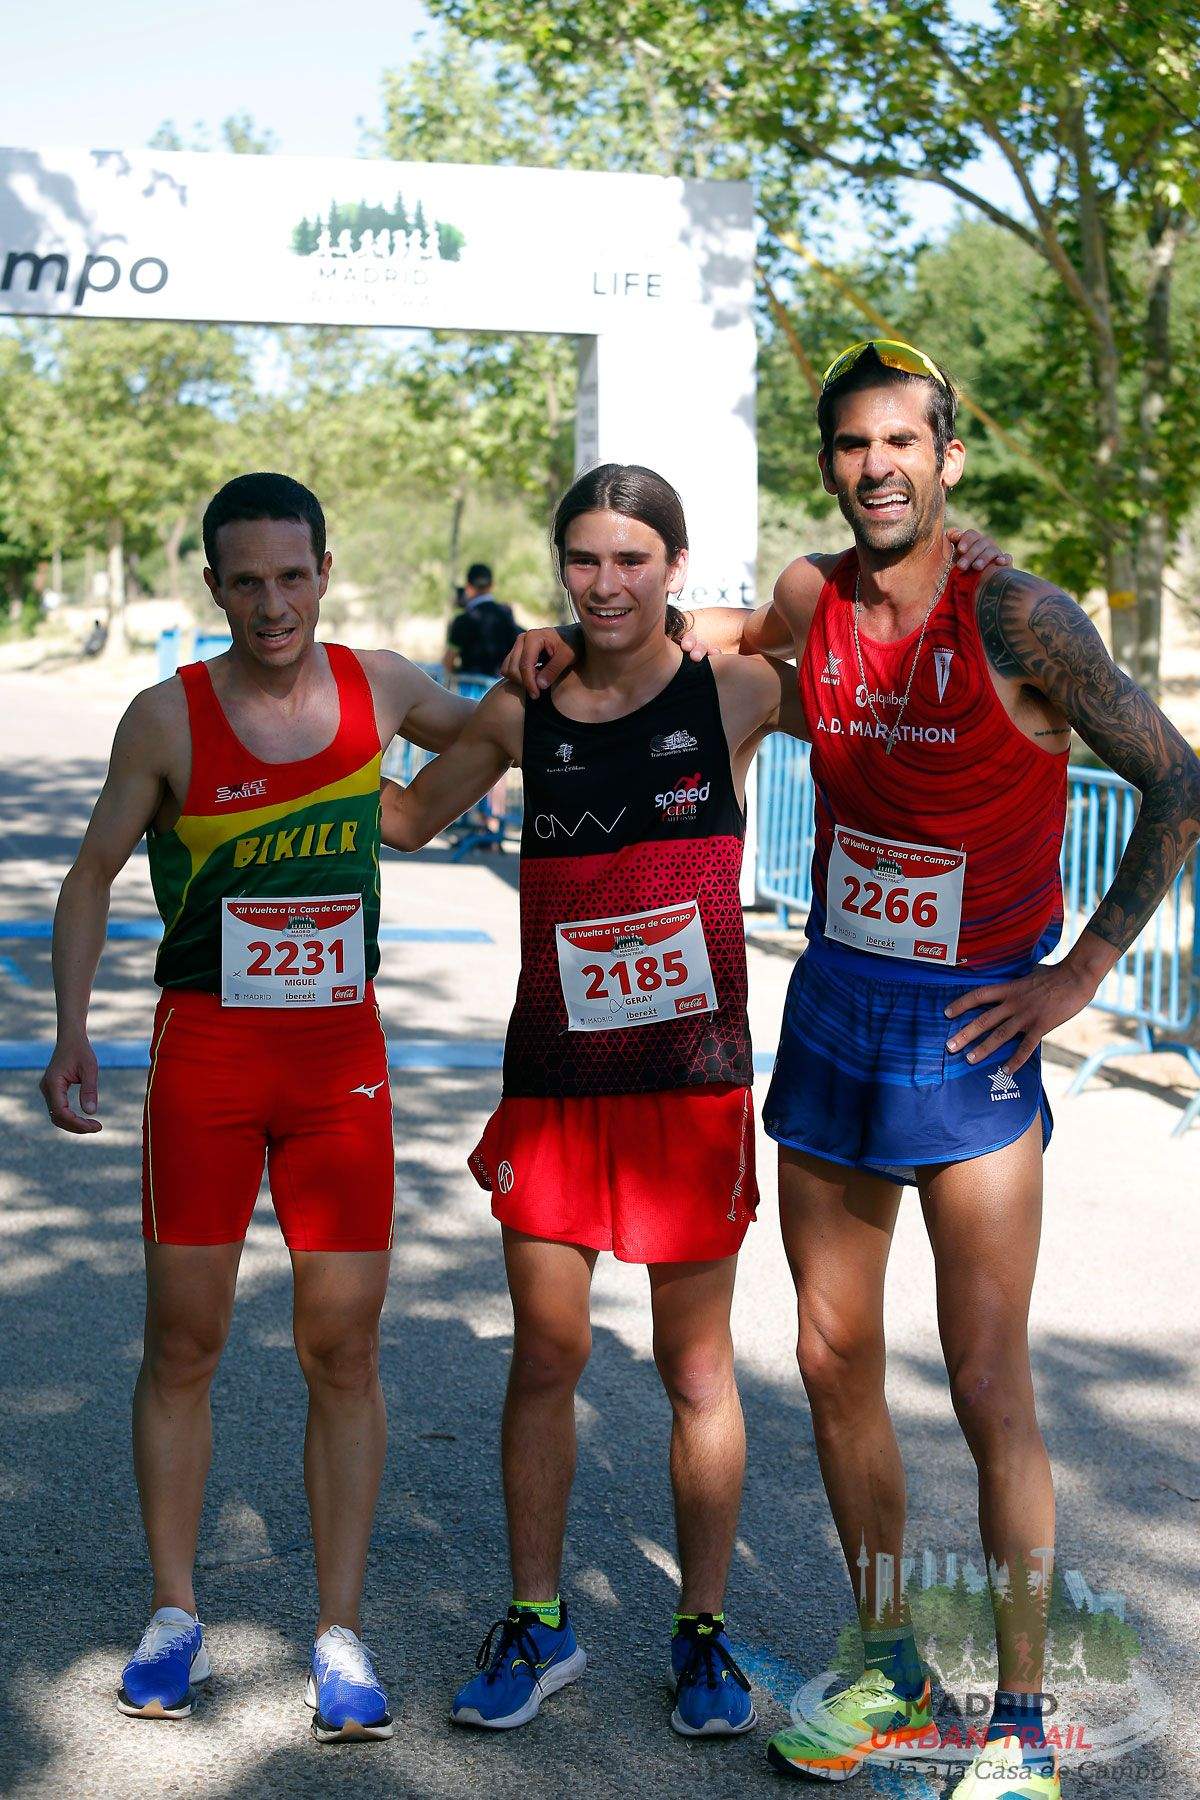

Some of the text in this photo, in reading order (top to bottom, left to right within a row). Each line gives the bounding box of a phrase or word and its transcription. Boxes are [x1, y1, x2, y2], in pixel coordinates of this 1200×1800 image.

[1, 252, 169, 306] mpo
[593, 271, 662, 297] LIFE
[817, 716, 845, 735] A.D.
[849, 720, 956, 743] MARATHON
[214, 786, 268, 803] SMILE
[654, 782, 711, 810] speed
[667, 804, 697, 816] CLUB
[841, 836, 850, 845] XII
[850, 839, 869, 851] Vuelta
[876, 846, 884, 855] la
[887, 849, 908, 860] Casa
[910, 853, 922, 861] de
[923, 855, 956, 866] Campo
[249, 906, 278, 914] Vuelta
[287, 906, 296, 914] la
[300, 906, 320, 914] Casa
[332, 904, 356, 912] Campo
[841, 875, 938, 928] 2266
[568, 931, 578, 939] XII
[578, 929, 603, 938] Vuelta
[624, 923, 646, 932] Casa
[647, 919, 659, 928] de
[660, 913, 691, 925] Campo
[246, 939, 344, 976] 2231
[580, 949, 689, 1000] 2185
[625, 994, 654, 1006] GERAY
[990, 1089, 1021, 1102] luanvi
